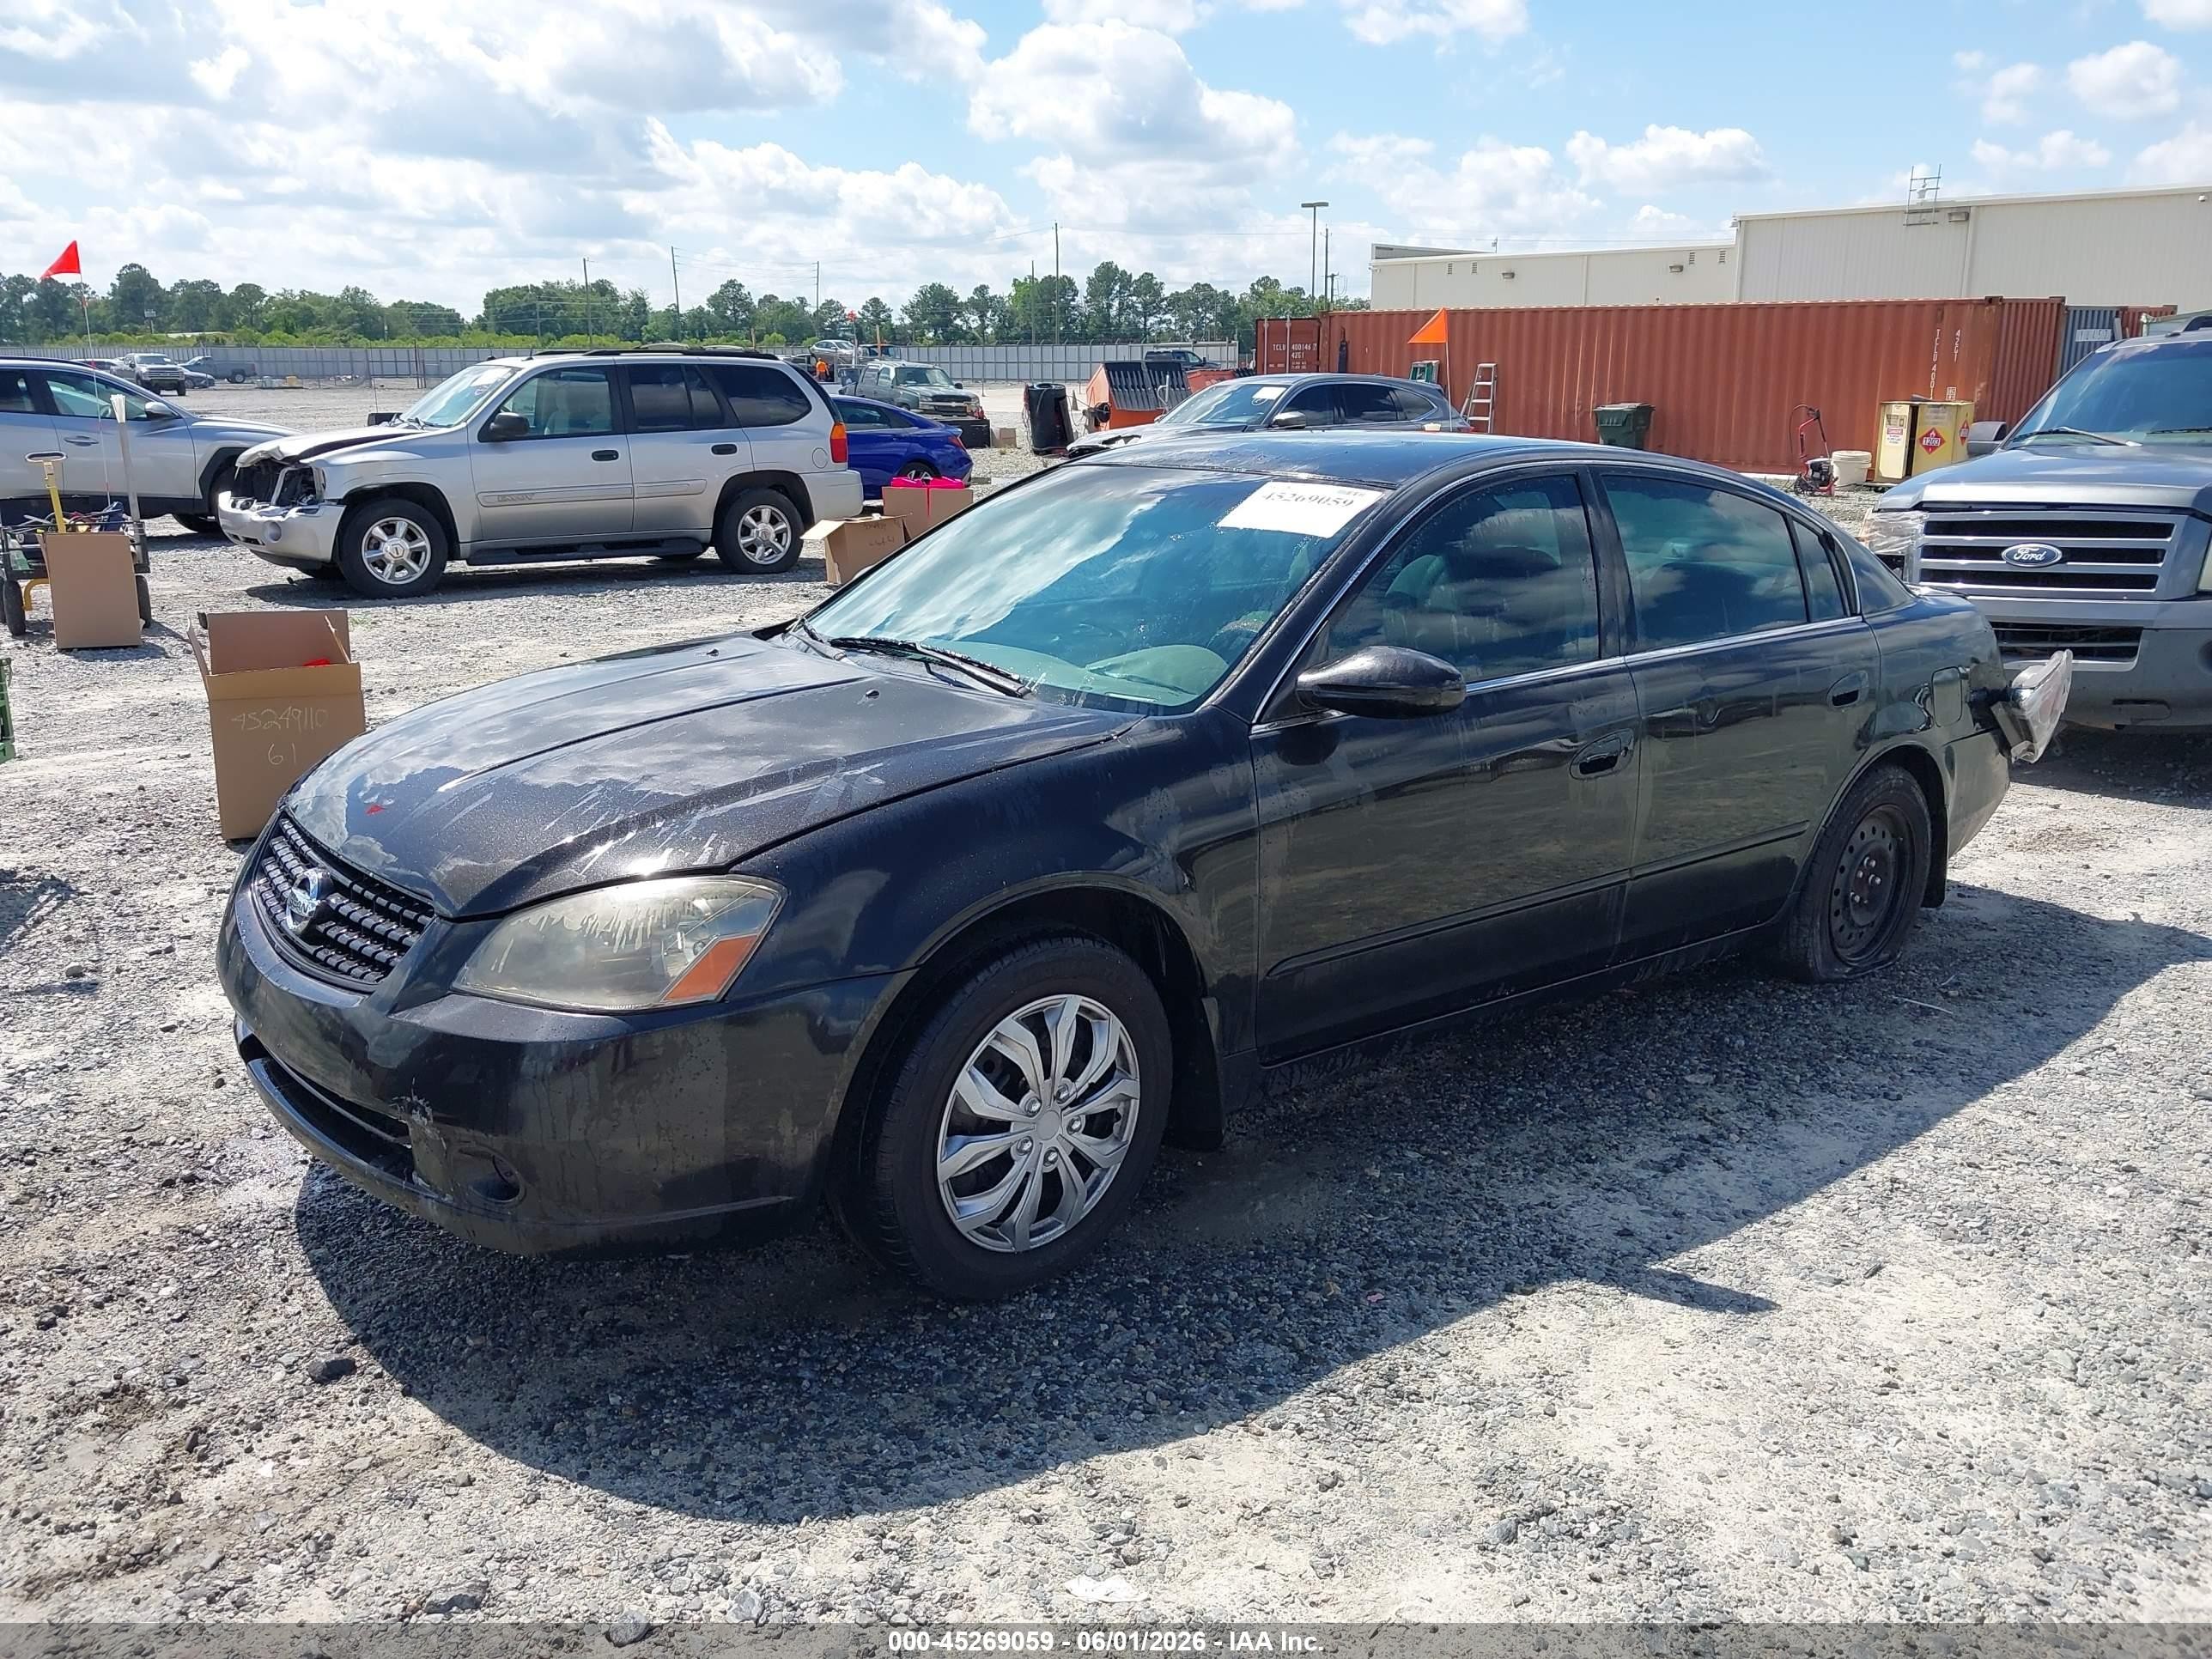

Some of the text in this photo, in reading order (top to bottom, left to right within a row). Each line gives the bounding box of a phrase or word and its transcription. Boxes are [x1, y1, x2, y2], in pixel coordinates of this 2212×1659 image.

[1923, 437, 1941, 446] 1203
[2014, 547, 2047, 561] Ford
[268, 742, 296, 766] 61
